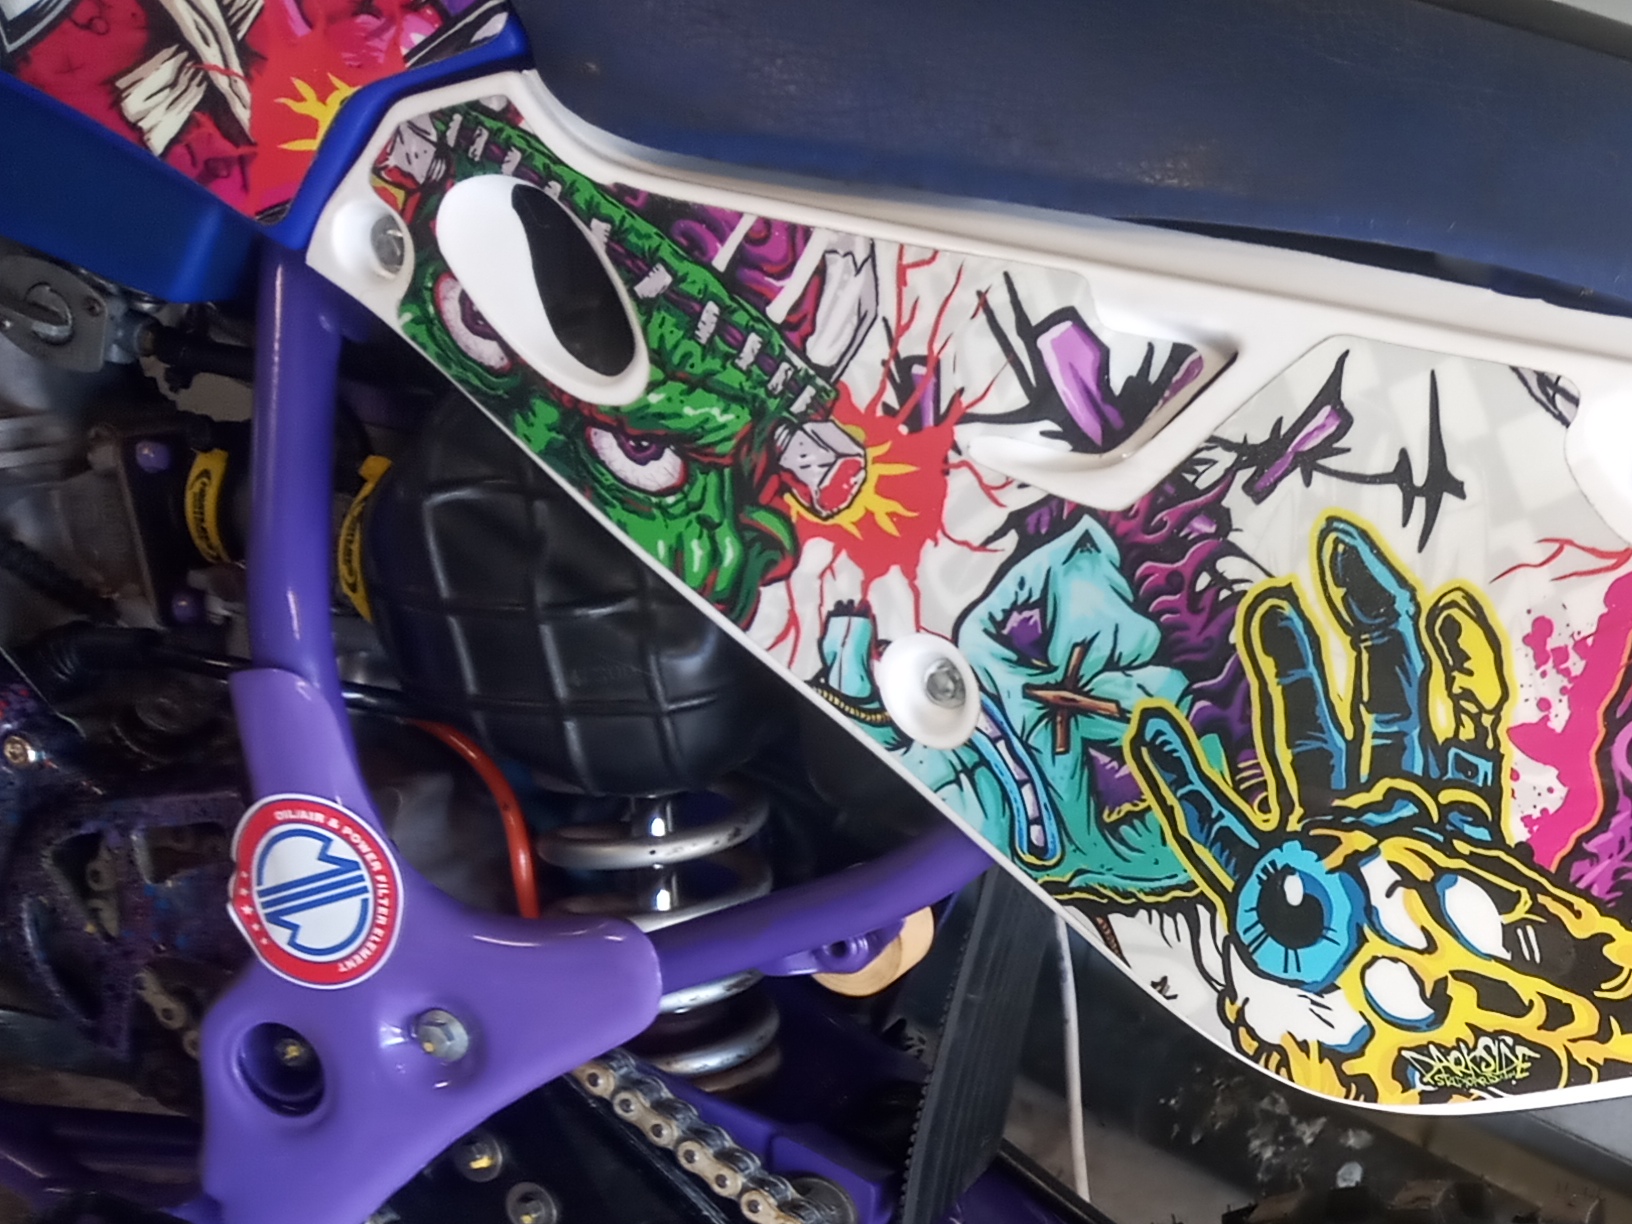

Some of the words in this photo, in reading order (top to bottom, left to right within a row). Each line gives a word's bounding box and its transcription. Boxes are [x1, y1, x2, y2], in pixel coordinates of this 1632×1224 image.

[327, 816, 341, 829] &
[340, 826, 383, 872] POWER
[375, 874, 392, 924] FILTER
[338, 926, 383, 973] ELEMENT
